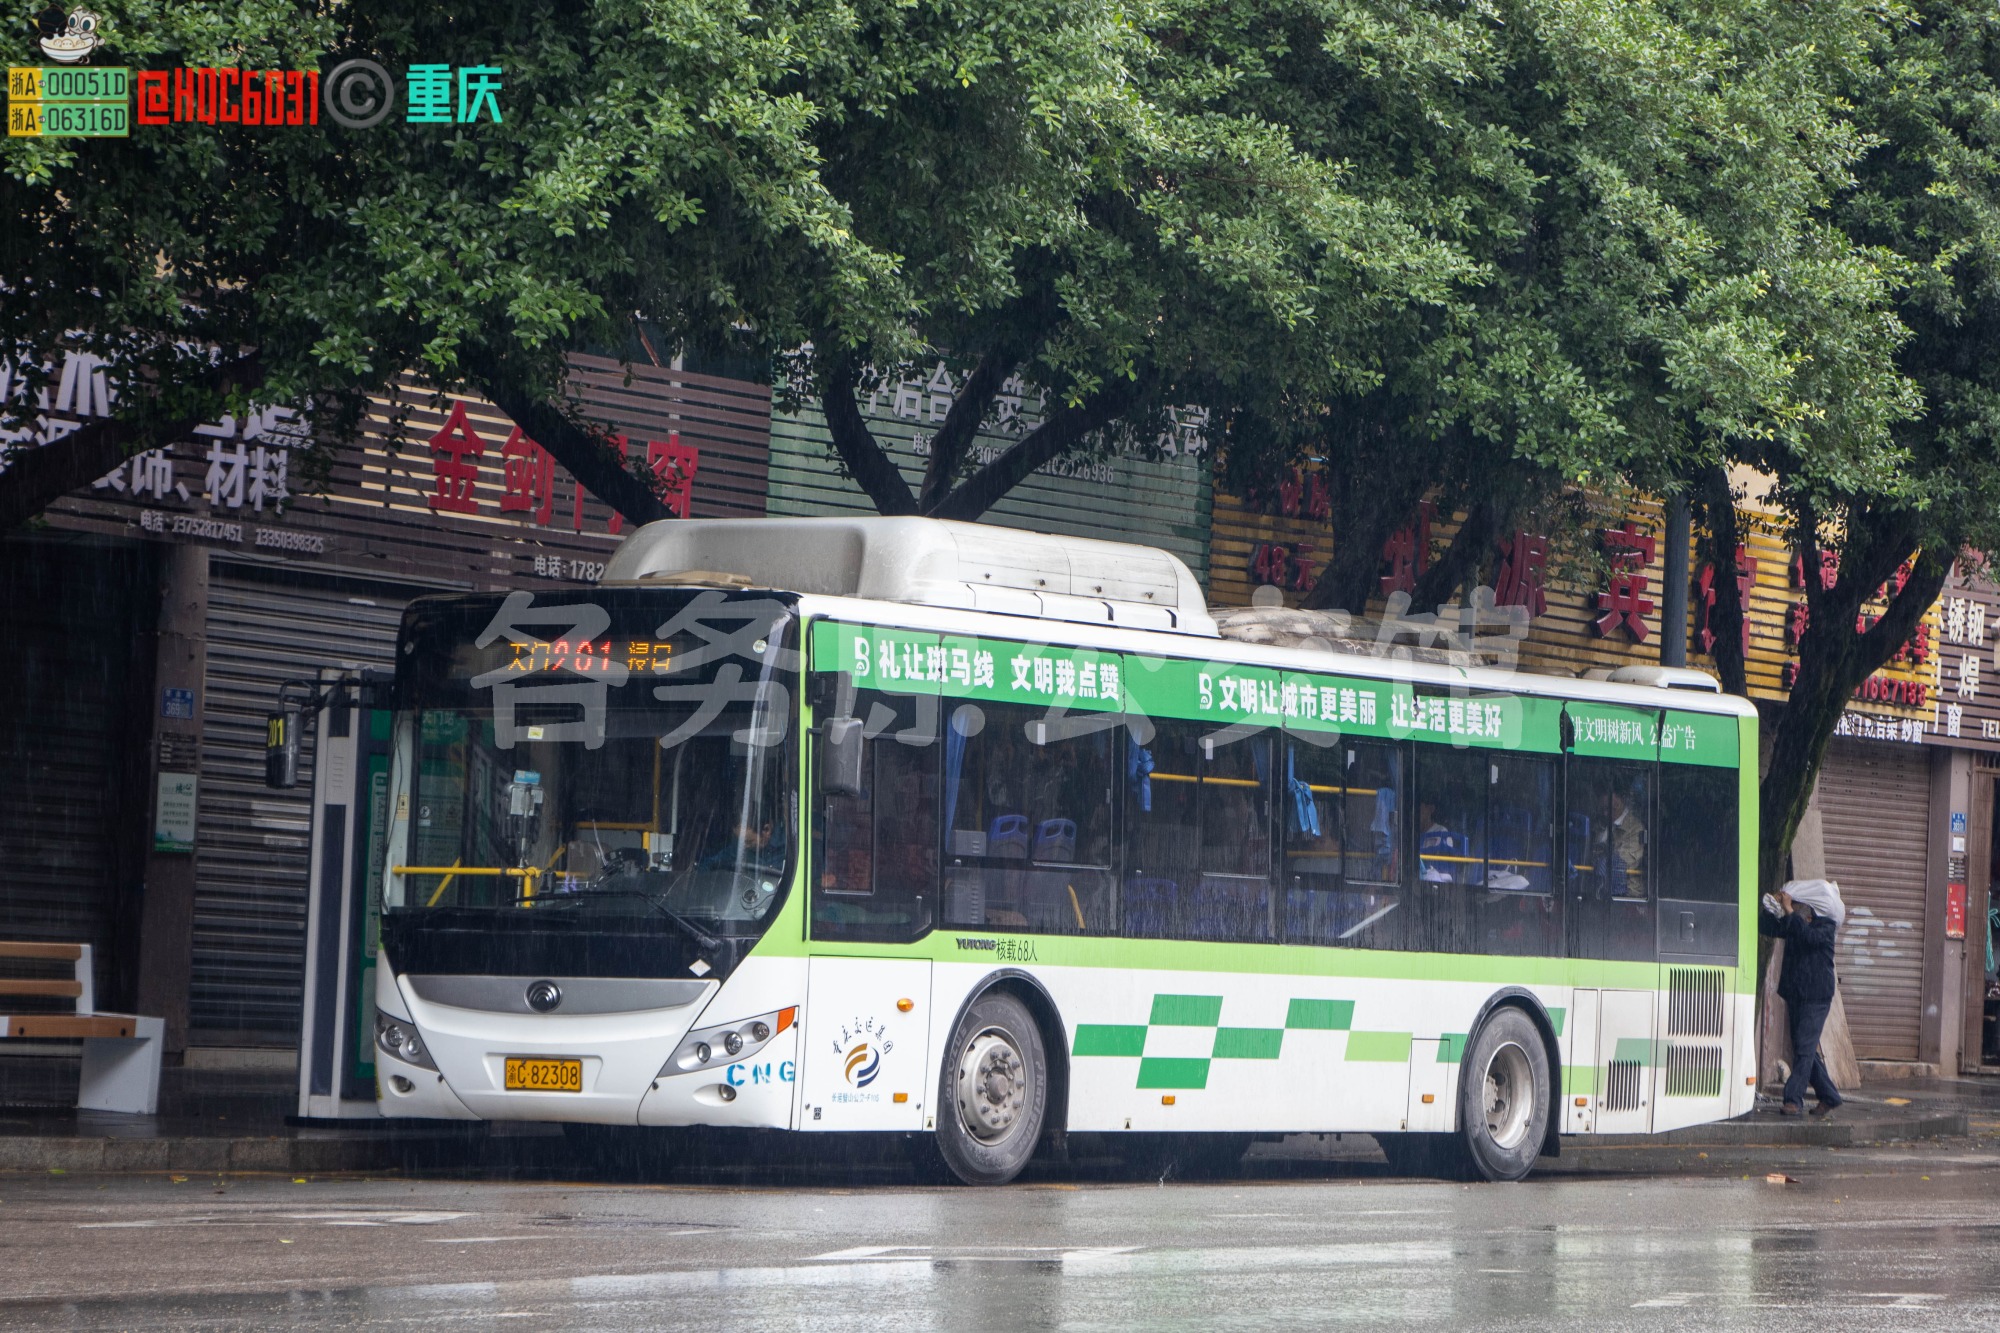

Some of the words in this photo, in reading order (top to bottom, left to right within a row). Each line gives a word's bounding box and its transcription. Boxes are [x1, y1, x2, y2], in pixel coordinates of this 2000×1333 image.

[1938, 597, 1986, 646] 锈钢
[879, 640, 994, 689] 礼让斑马线
[1011, 653, 1120, 701] 文明我点赞
[1218, 678, 1376, 726] 文明让城市更美丽
[1391, 694, 1502, 738] 让生活更美好
[268, 718, 284, 748] 201
[996, 938, 1038, 962] 核载68人
[726, 1060, 795, 1086] CNG
